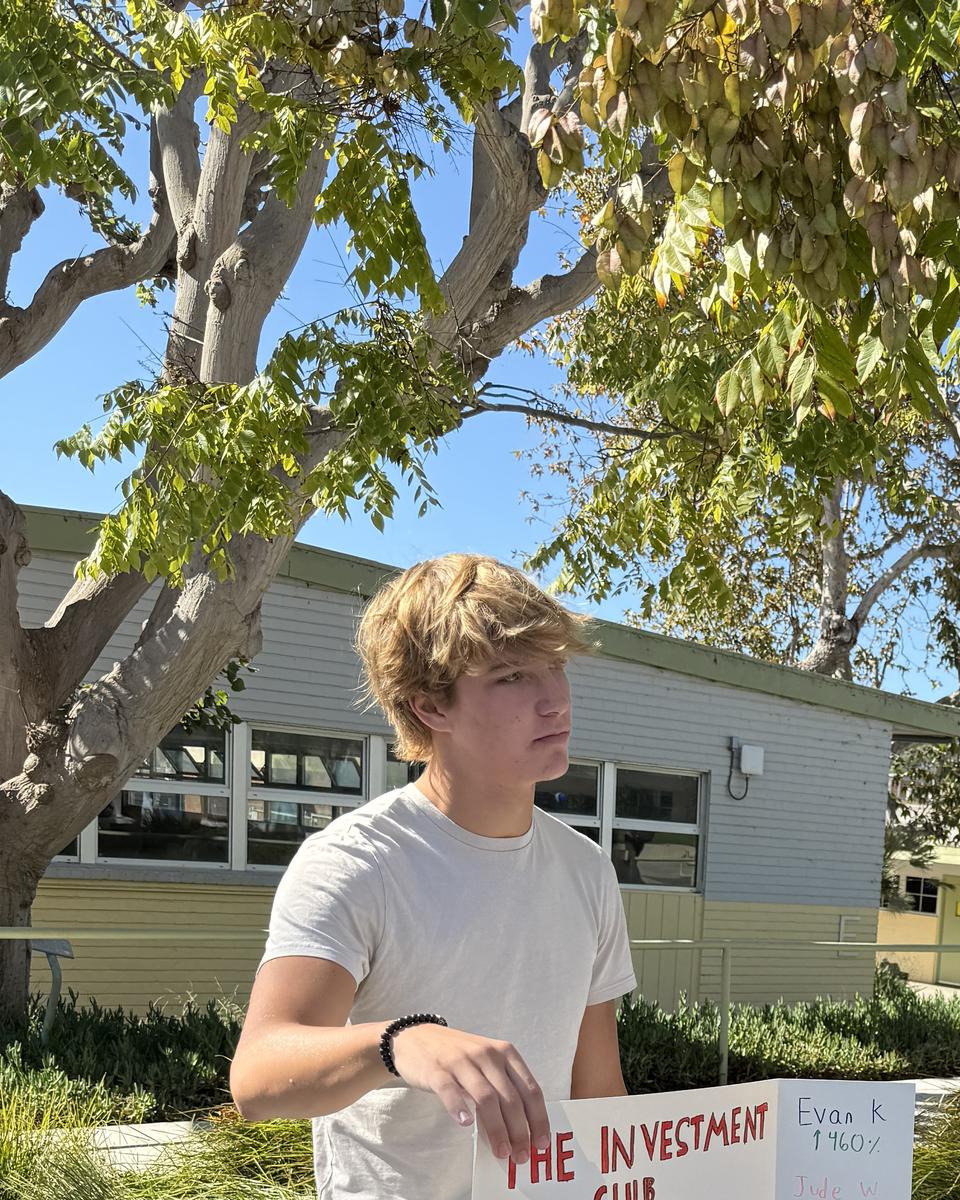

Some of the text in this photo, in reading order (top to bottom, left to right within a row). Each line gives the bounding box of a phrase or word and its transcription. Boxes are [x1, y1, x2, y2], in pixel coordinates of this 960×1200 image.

[799, 1097, 887, 1126] Evan K
[601, 1102, 769, 1174] INVESTMENT
[794, 1175, 878, 1200] Jude W
